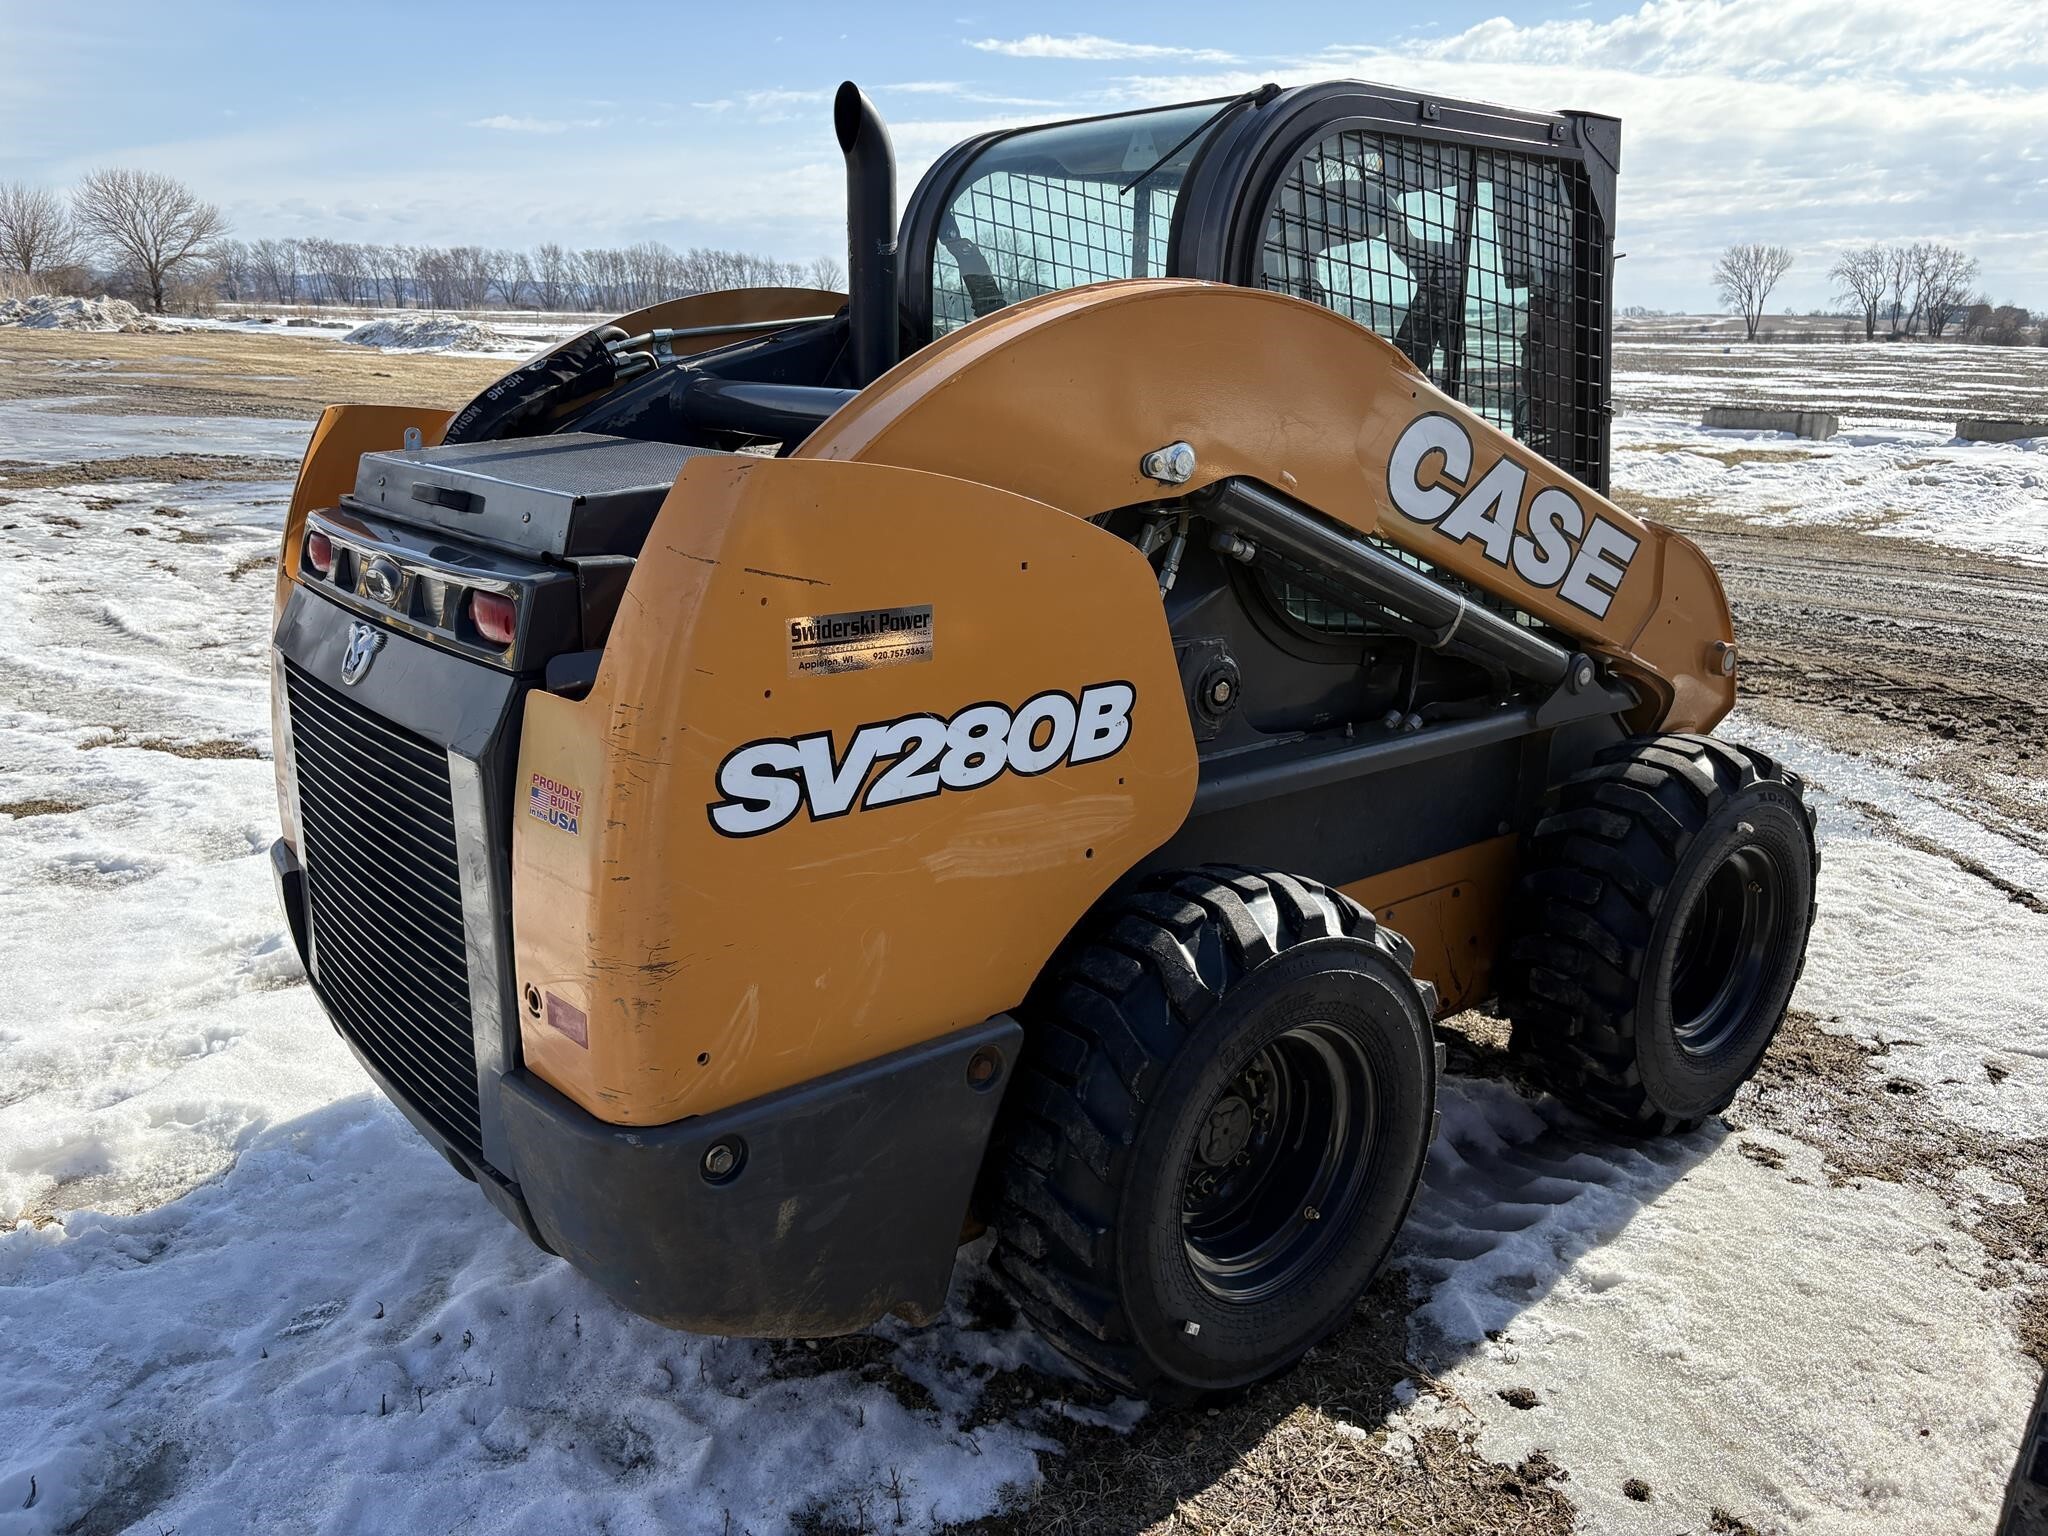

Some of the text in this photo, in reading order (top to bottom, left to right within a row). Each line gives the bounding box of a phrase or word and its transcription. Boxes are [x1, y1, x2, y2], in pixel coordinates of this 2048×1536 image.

[450, 405, 482, 435] MSHA
[1386, 410, 1641, 621] CASE
[791, 613, 930, 643] Swiderski Power
[842, 656, 854, 664] WI
[873, 646, 925, 660] 920.757.9363
[706, 680, 1136, 838] SV280B
[533, 773, 581, 802] PROUDLY
[550, 795, 581, 816] BUILT
[529, 806, 578, 835] in the USA
